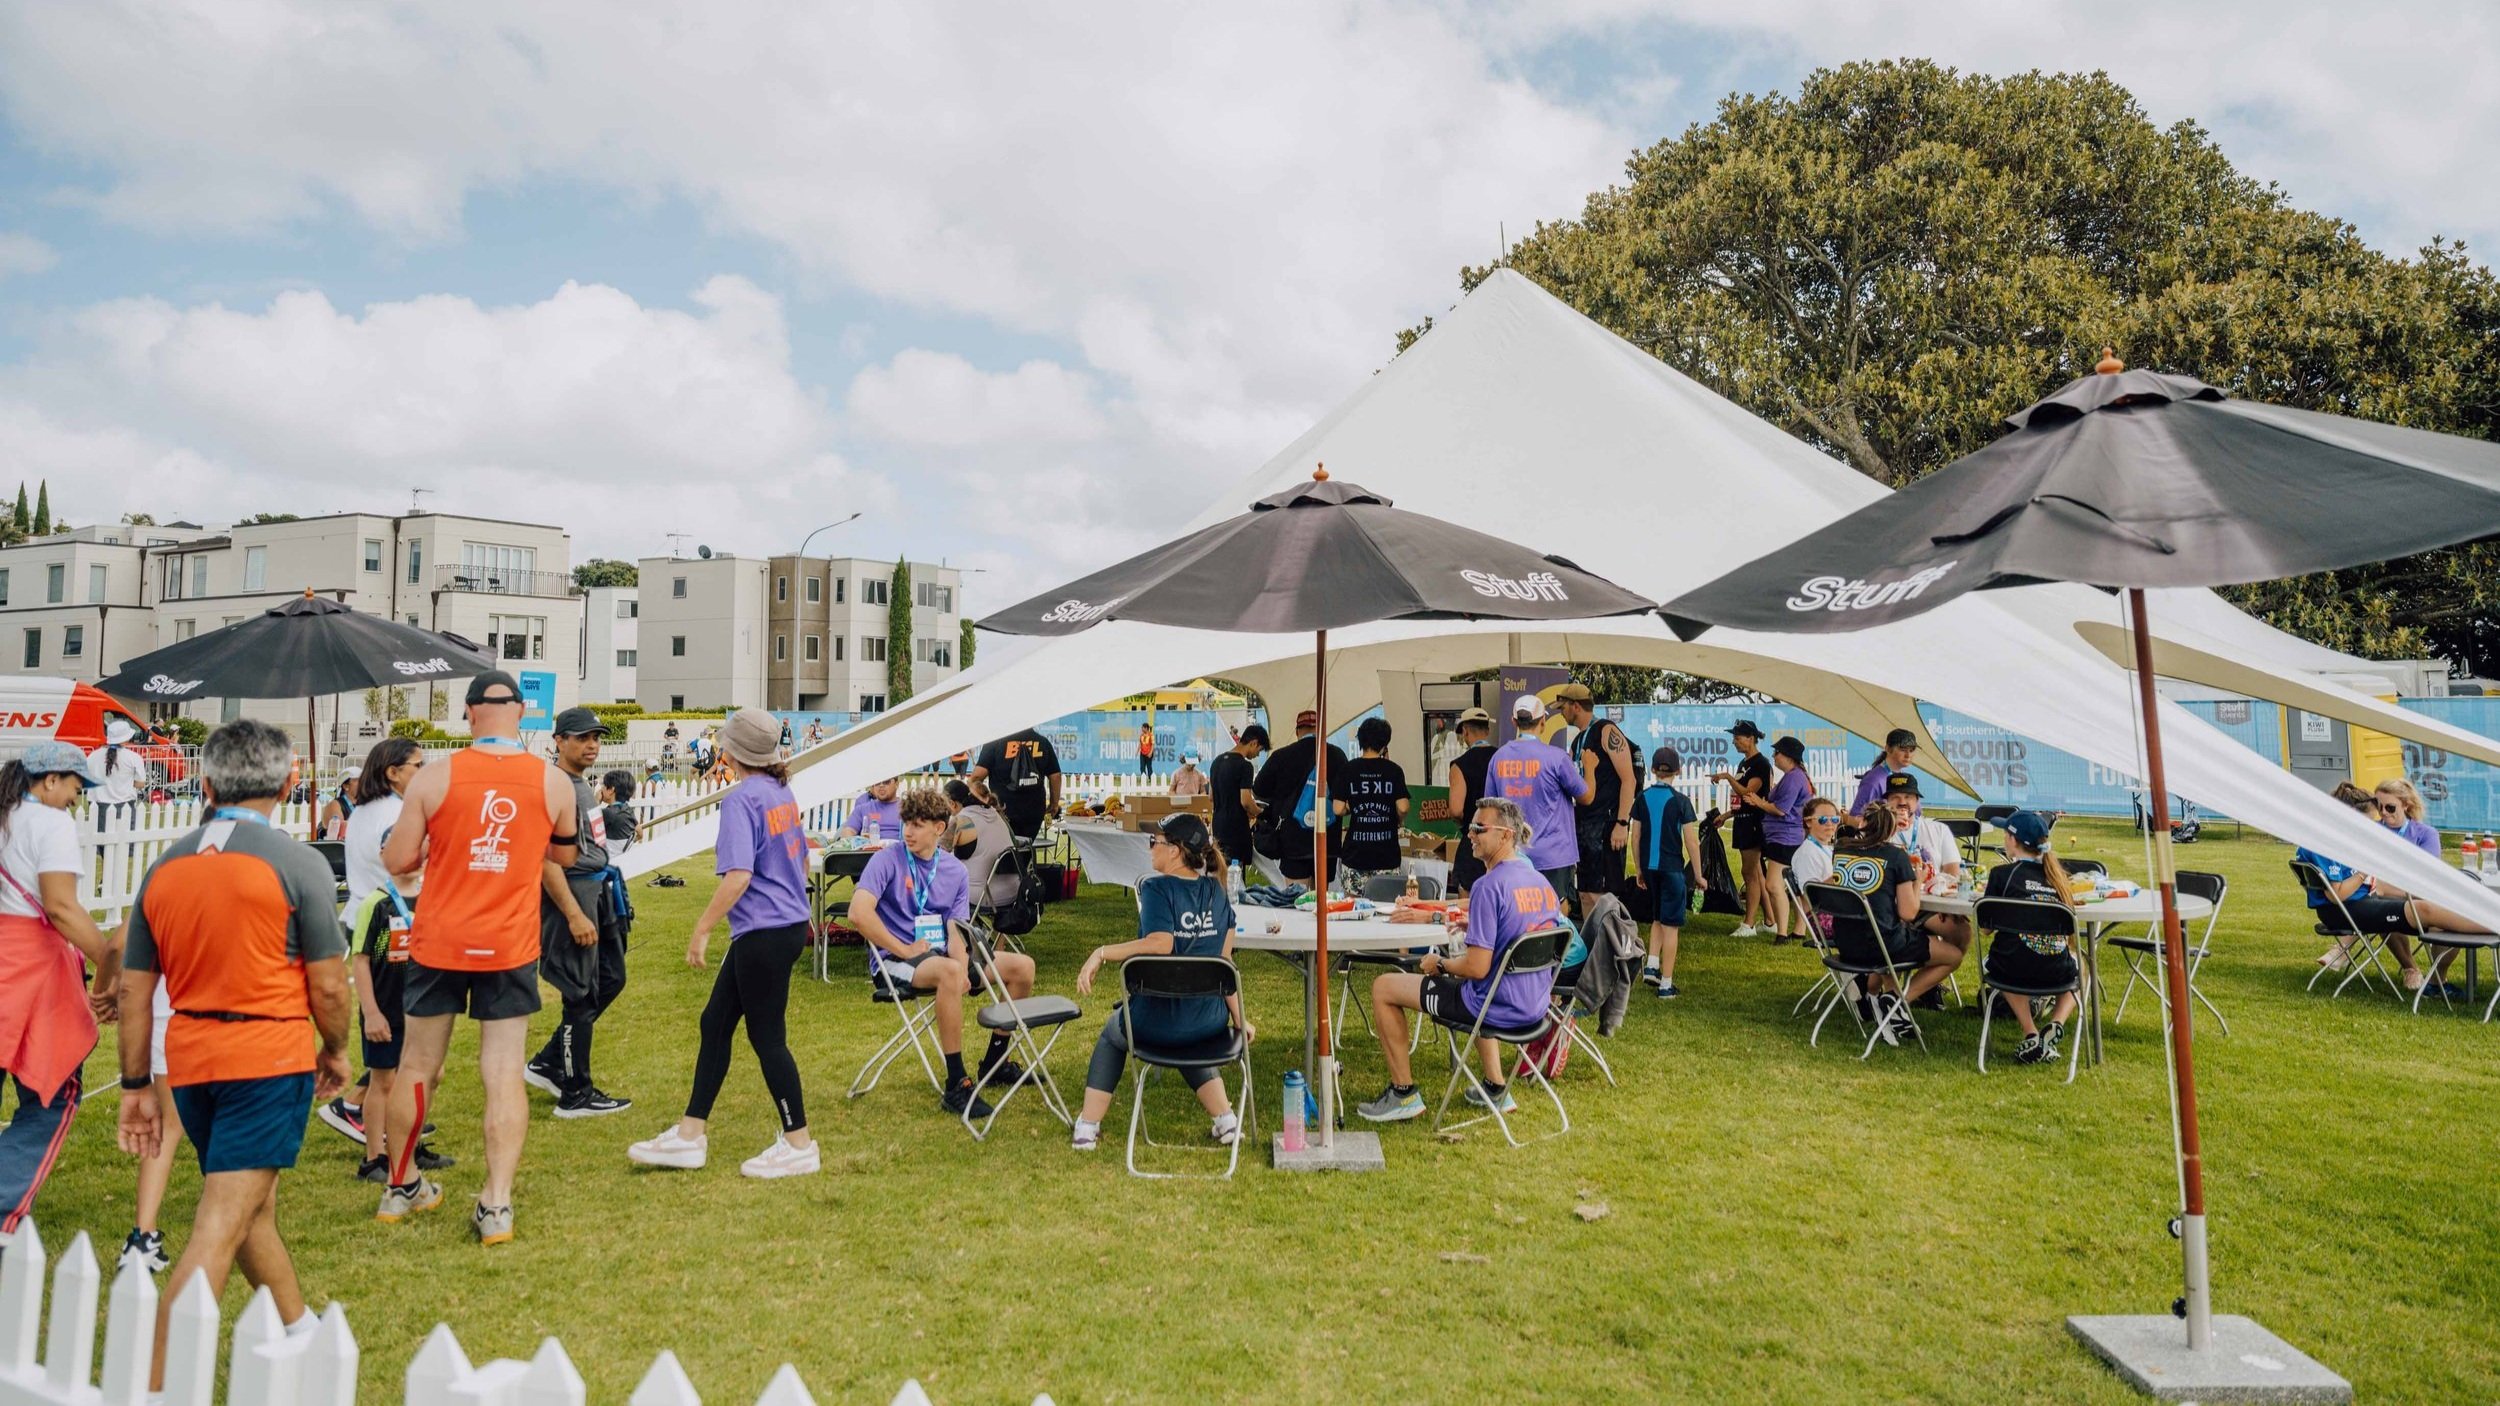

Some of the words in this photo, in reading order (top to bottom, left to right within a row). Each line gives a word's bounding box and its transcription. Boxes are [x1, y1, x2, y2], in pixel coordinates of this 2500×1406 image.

[1460, 569, 1569, 602] Stuff
[1786, 560, 1958, 612] Stuff
[392, 657, 453, 676] Stuff
[143, 673, 204, 696] Stuff
[1503, 677, 1528, 692] Stuff
[2219, 711, 2247, 719] Events
[1666, 724, 1703, 733] Southern
[1944, 724, 1996, 736] Southern
[1100, 741, 1118, 759] FUN
[1663, 737, 1729, 755] ROUND
[1942, 740, 2027, 761] ROUND
[1497, 760, 1523, 778] KEEP
[1525, 760, 1540, 778] UP
[1956, 761, 2028, 788] BAYS
[1421, 800, 1448, 810] CATER
[1180, 910, 1214, 930] CAE
